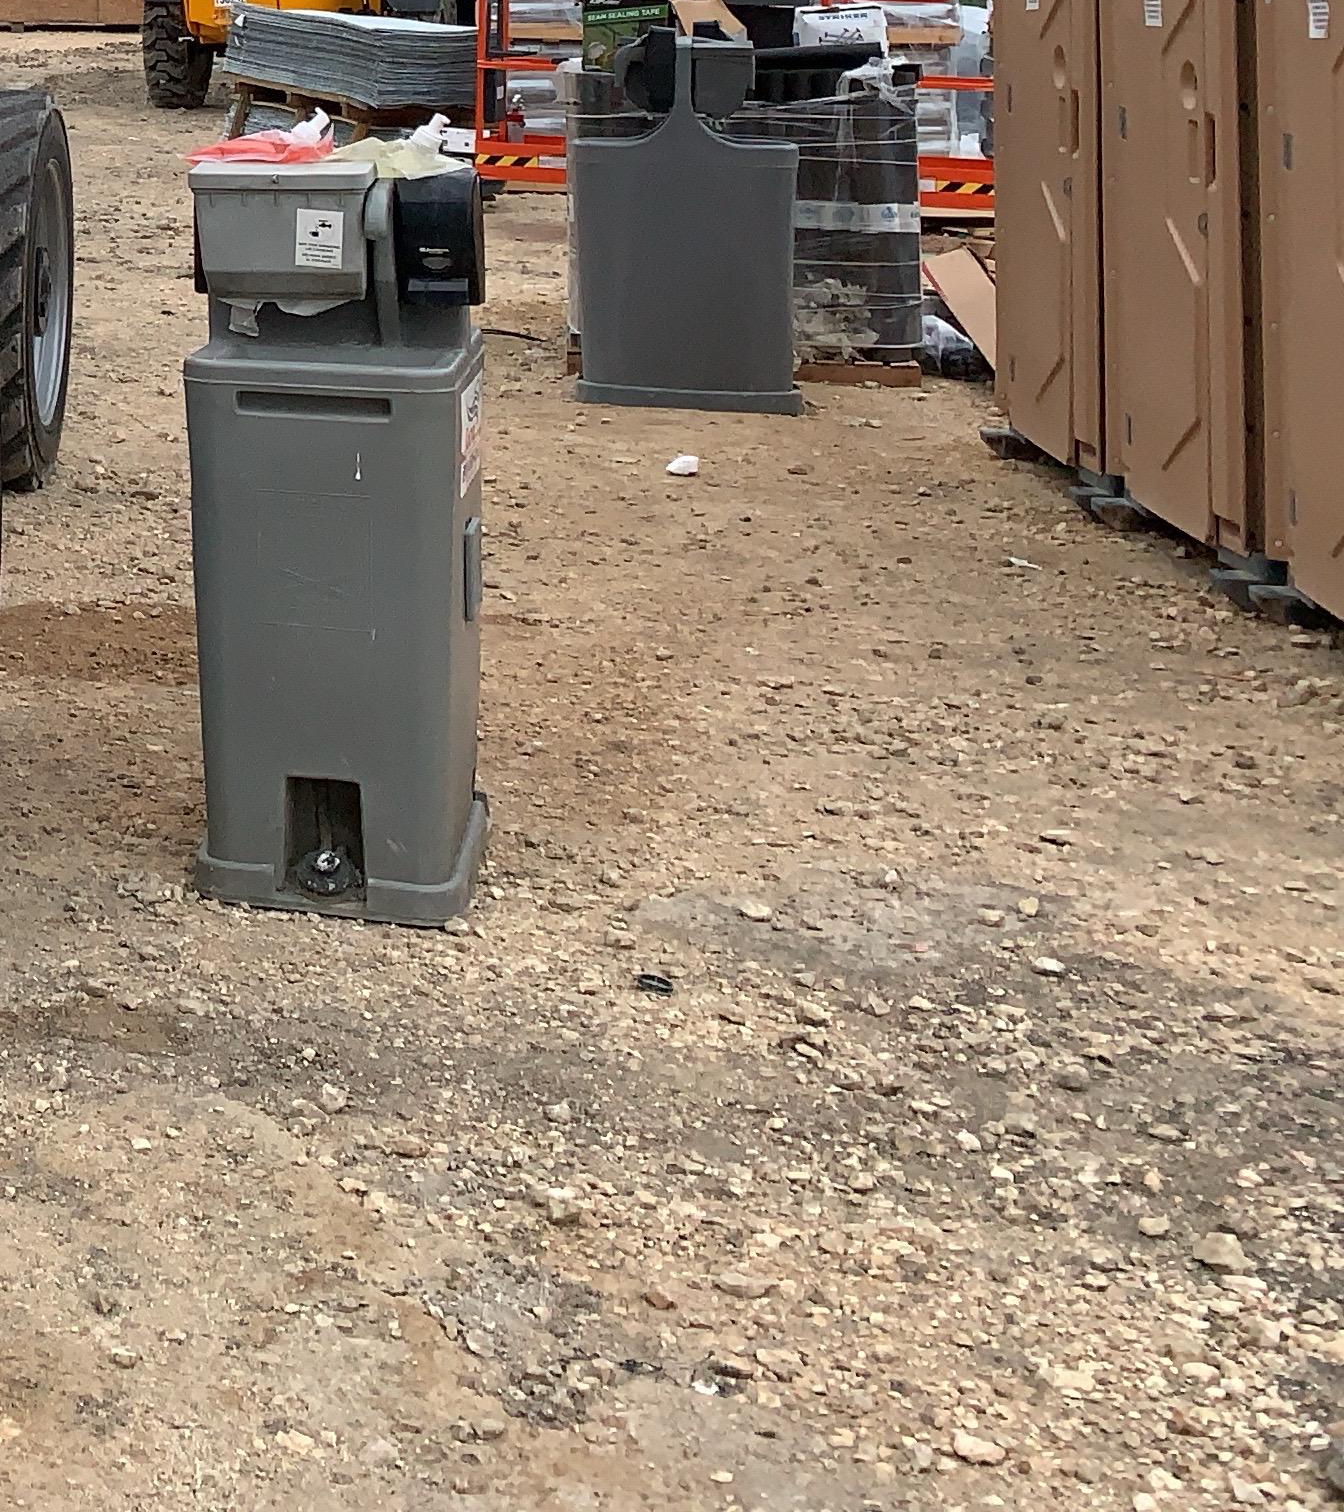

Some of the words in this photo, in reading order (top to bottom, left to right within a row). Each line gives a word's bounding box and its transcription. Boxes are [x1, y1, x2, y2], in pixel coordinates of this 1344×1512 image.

[587, 13, 607, 22] SEAM
[608, 10, 639, 19] SEALING
[642, 8, 661, 16] TAPE
